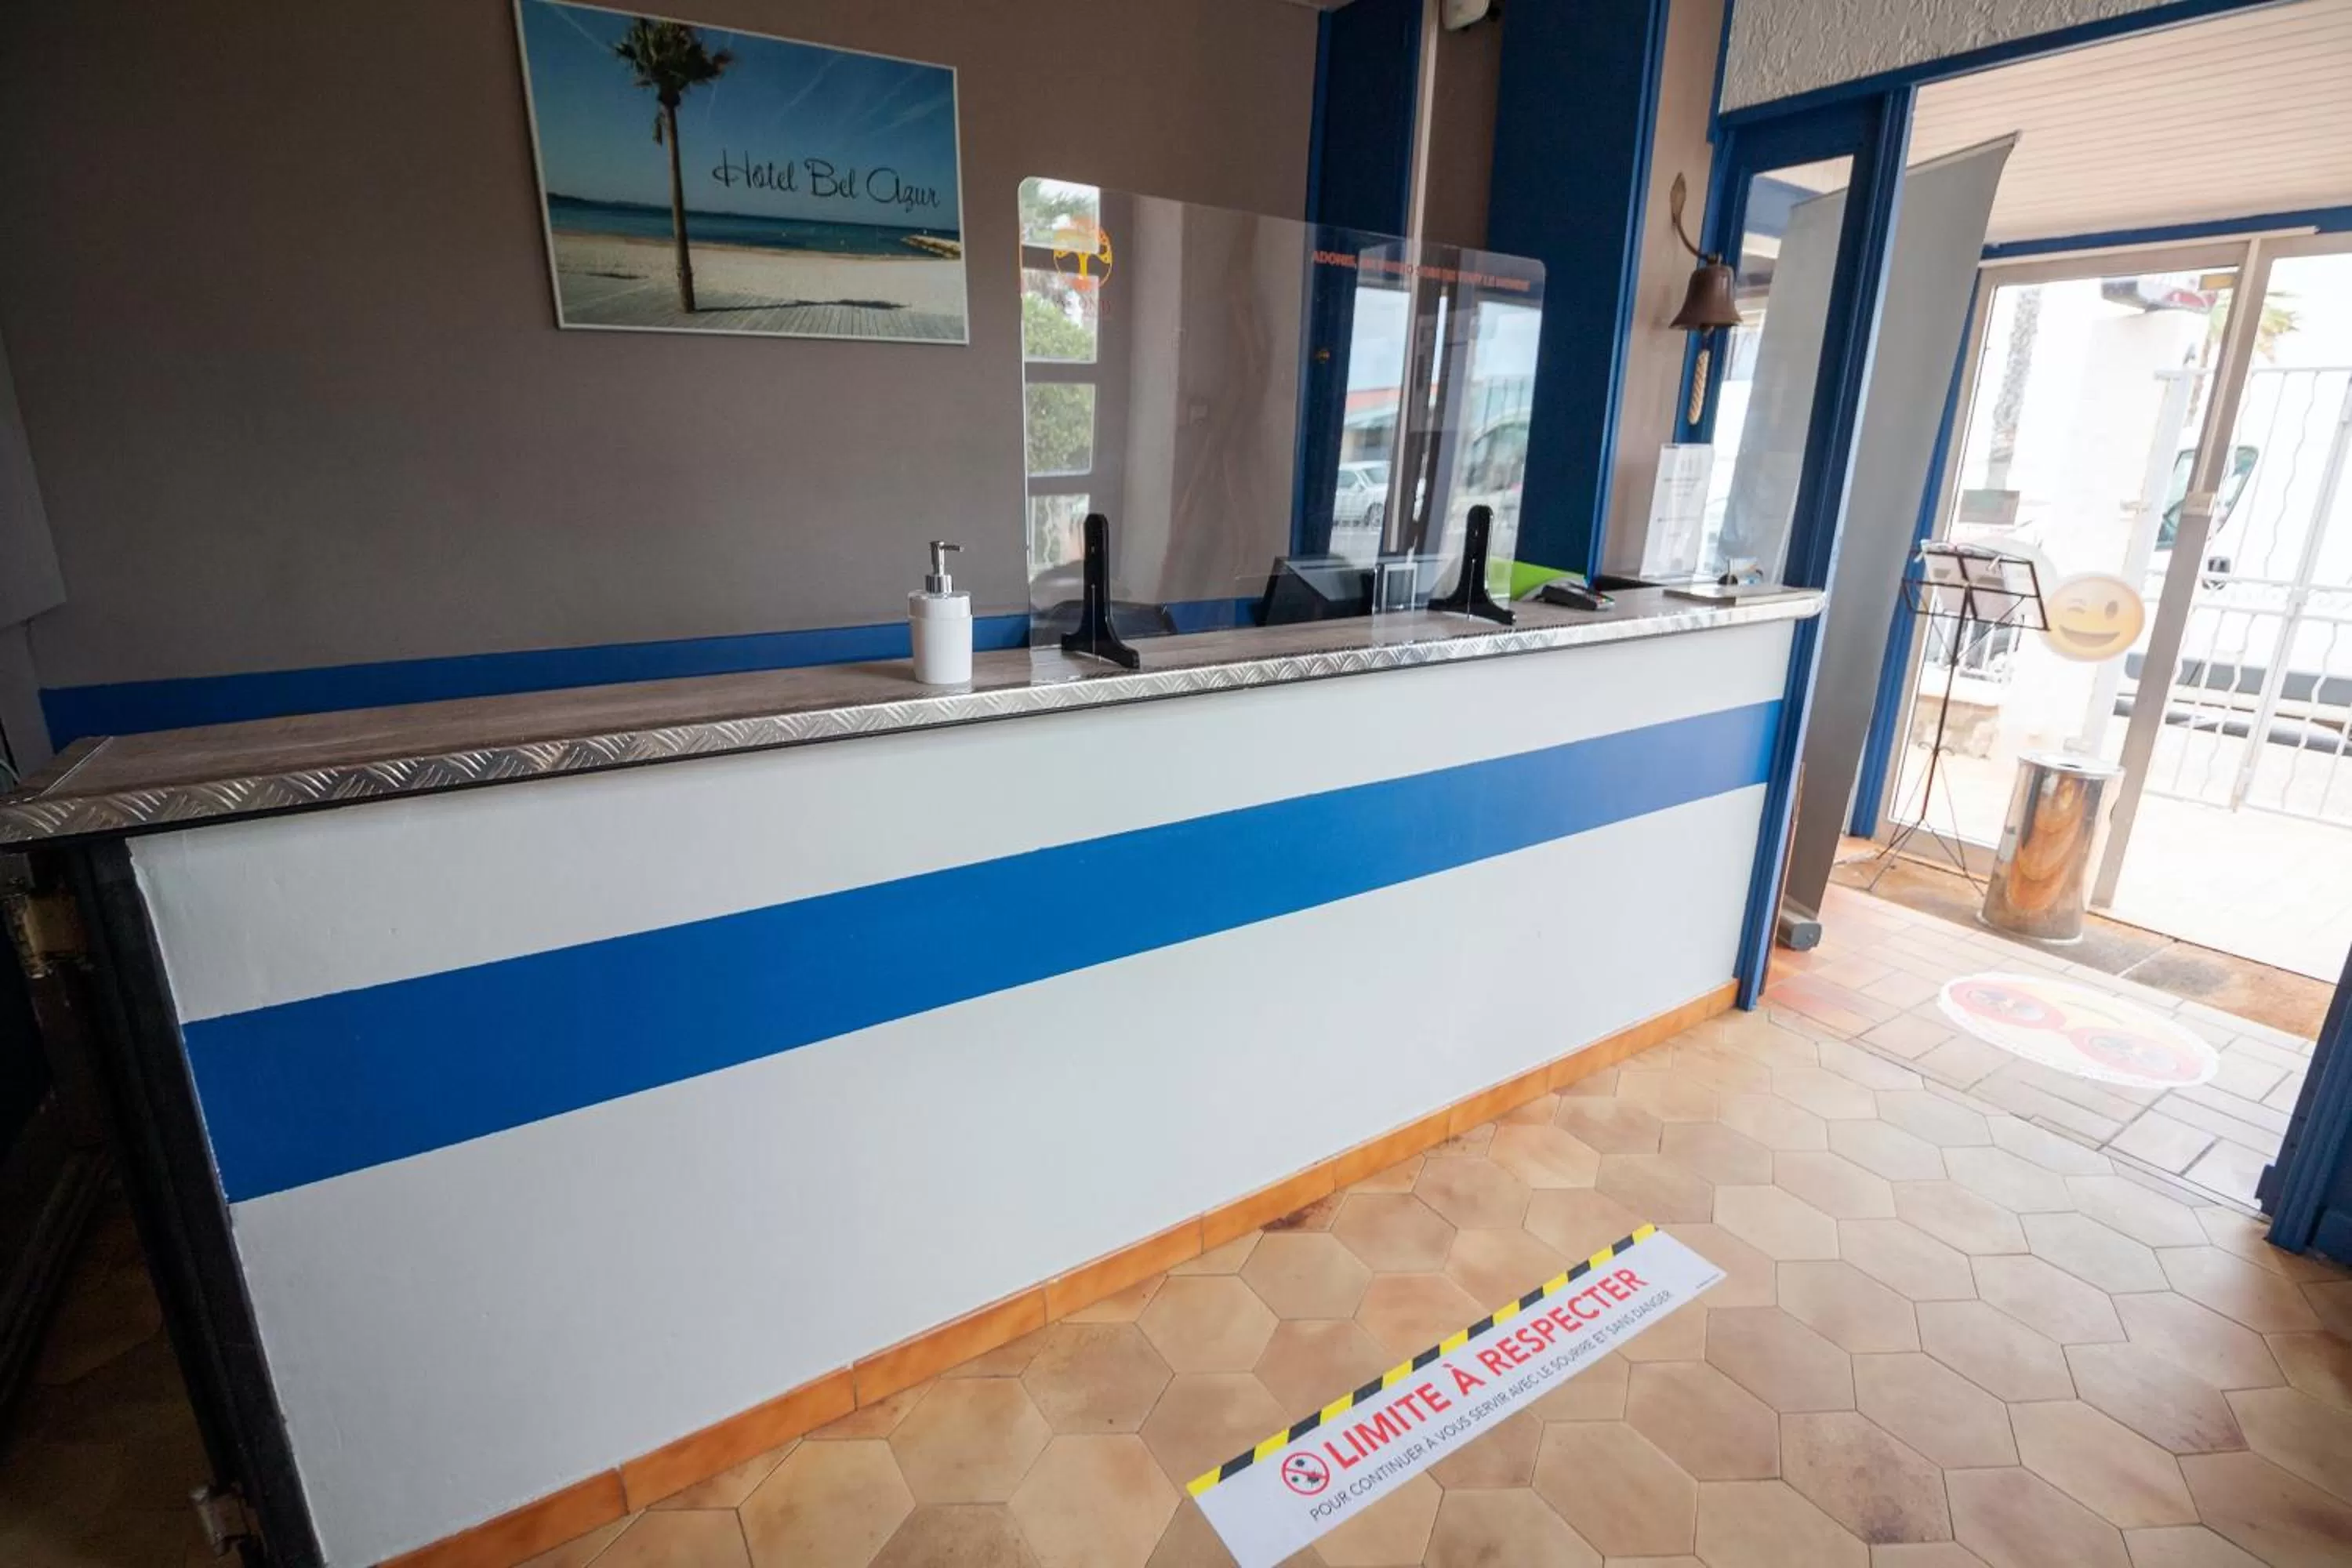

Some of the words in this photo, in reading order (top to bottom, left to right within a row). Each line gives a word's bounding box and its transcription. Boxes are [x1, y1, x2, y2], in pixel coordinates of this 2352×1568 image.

[804, 157, 859, 198] Bel
[866, 167, 940, 212] Azur
[1309, 1490, 1352, 1522] POUR
[1349, 1443, 1425, 1497] CONTINUER
[1423, 1434, 1438, 1451] À
[1435, 1414, 1472, 1442] VOUS
[1468, 1390, 1511, 1422] SERVIR
[1507, 1374, 1540, 1399] AVEC
[1537, 1363, 1555, 1381] LE
[1550, 1339, 1595, 1370] SOURIRE
[1592, 1330, 1609, 1346] ET
[1604, 1314, 1636, 1336] SANS
[1631, 1290, 1672, 1319] DANGER
[1323, 1382, 1452, 1470] LIMITE
[1442, 1363, 1486, 1396] À
[1475, 1268, 1650, 1377] RESPECTER
